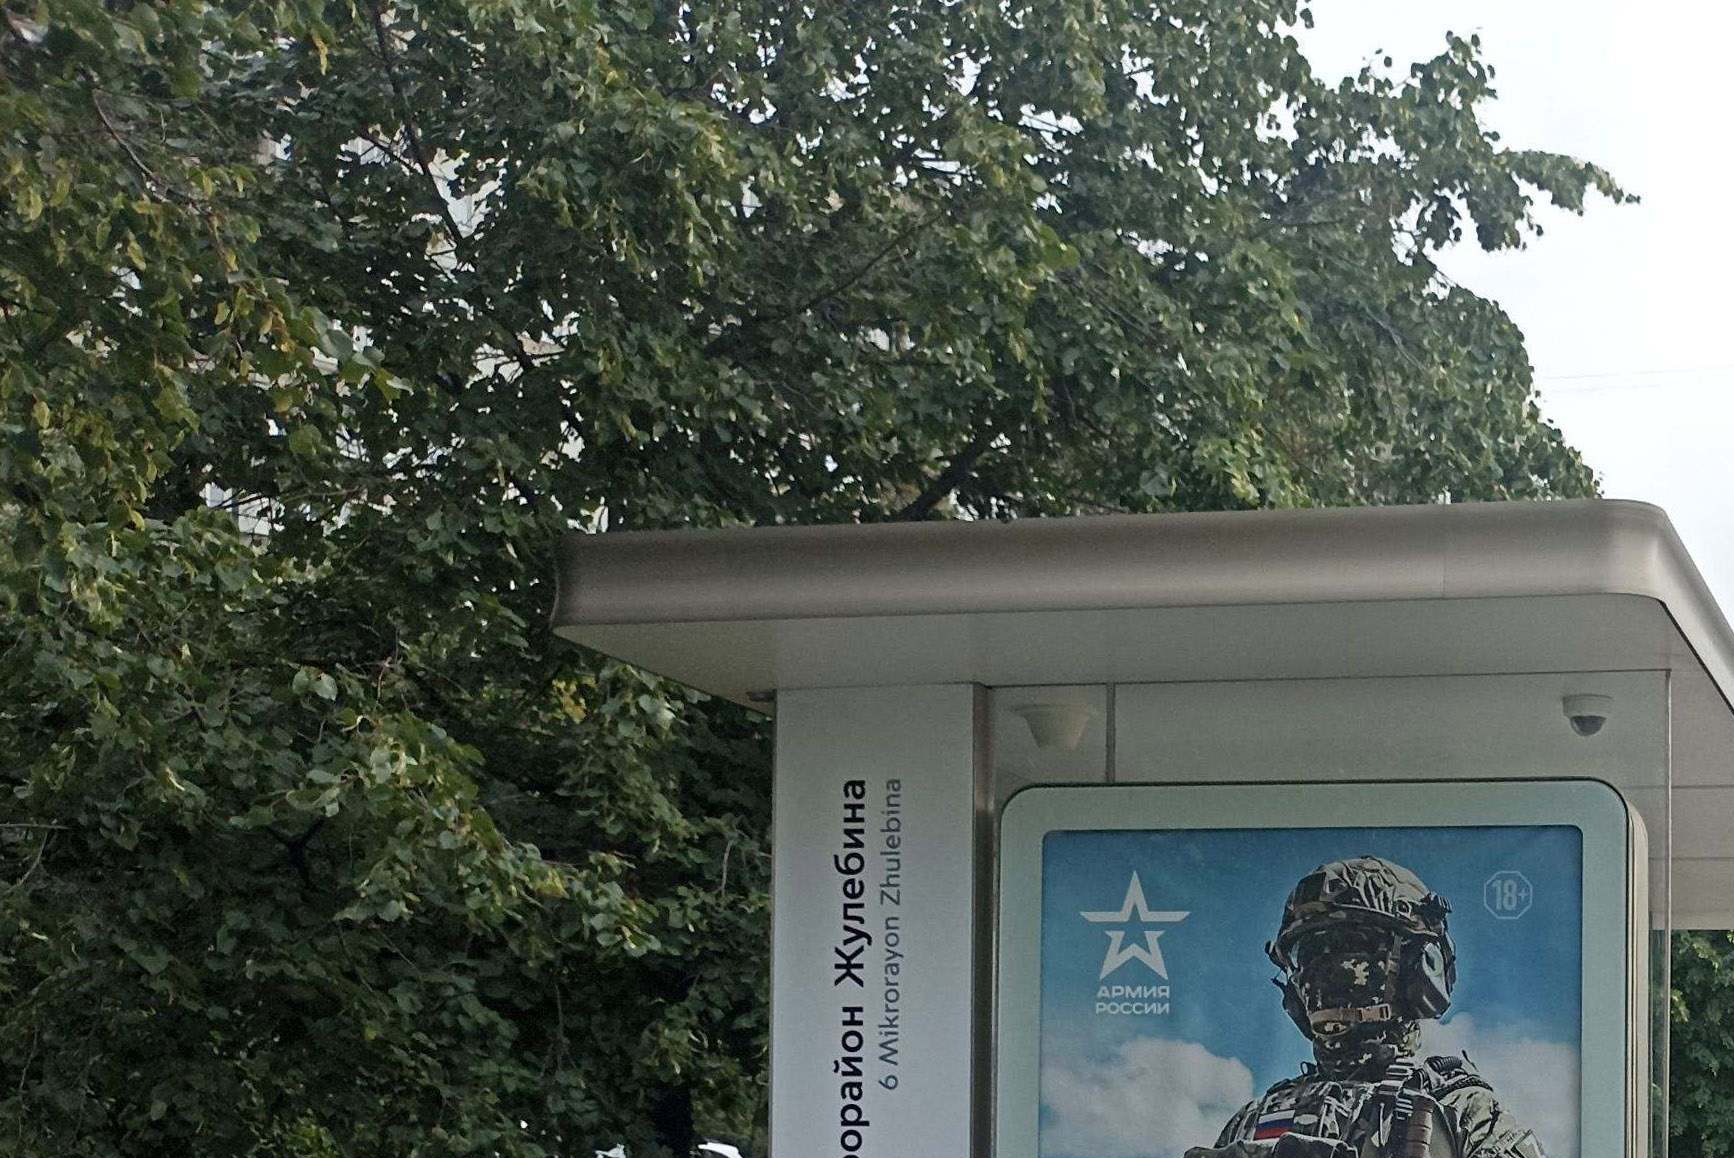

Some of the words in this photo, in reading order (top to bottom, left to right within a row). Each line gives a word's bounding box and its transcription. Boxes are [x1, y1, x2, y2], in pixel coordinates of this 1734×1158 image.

[880, 779, 902, 905] Zhulebina
[833, 780, 872, 987] Жулебина
[1492, 879, 1529, 911] 18+
[878, 916, 903, 1065] Mikrorayon
[1096, 985, 1170, 999] АРМИЯ
[1095, 1002, 1170, 1015] РОССИИ
[878, 1075, 898, 1090] 6
